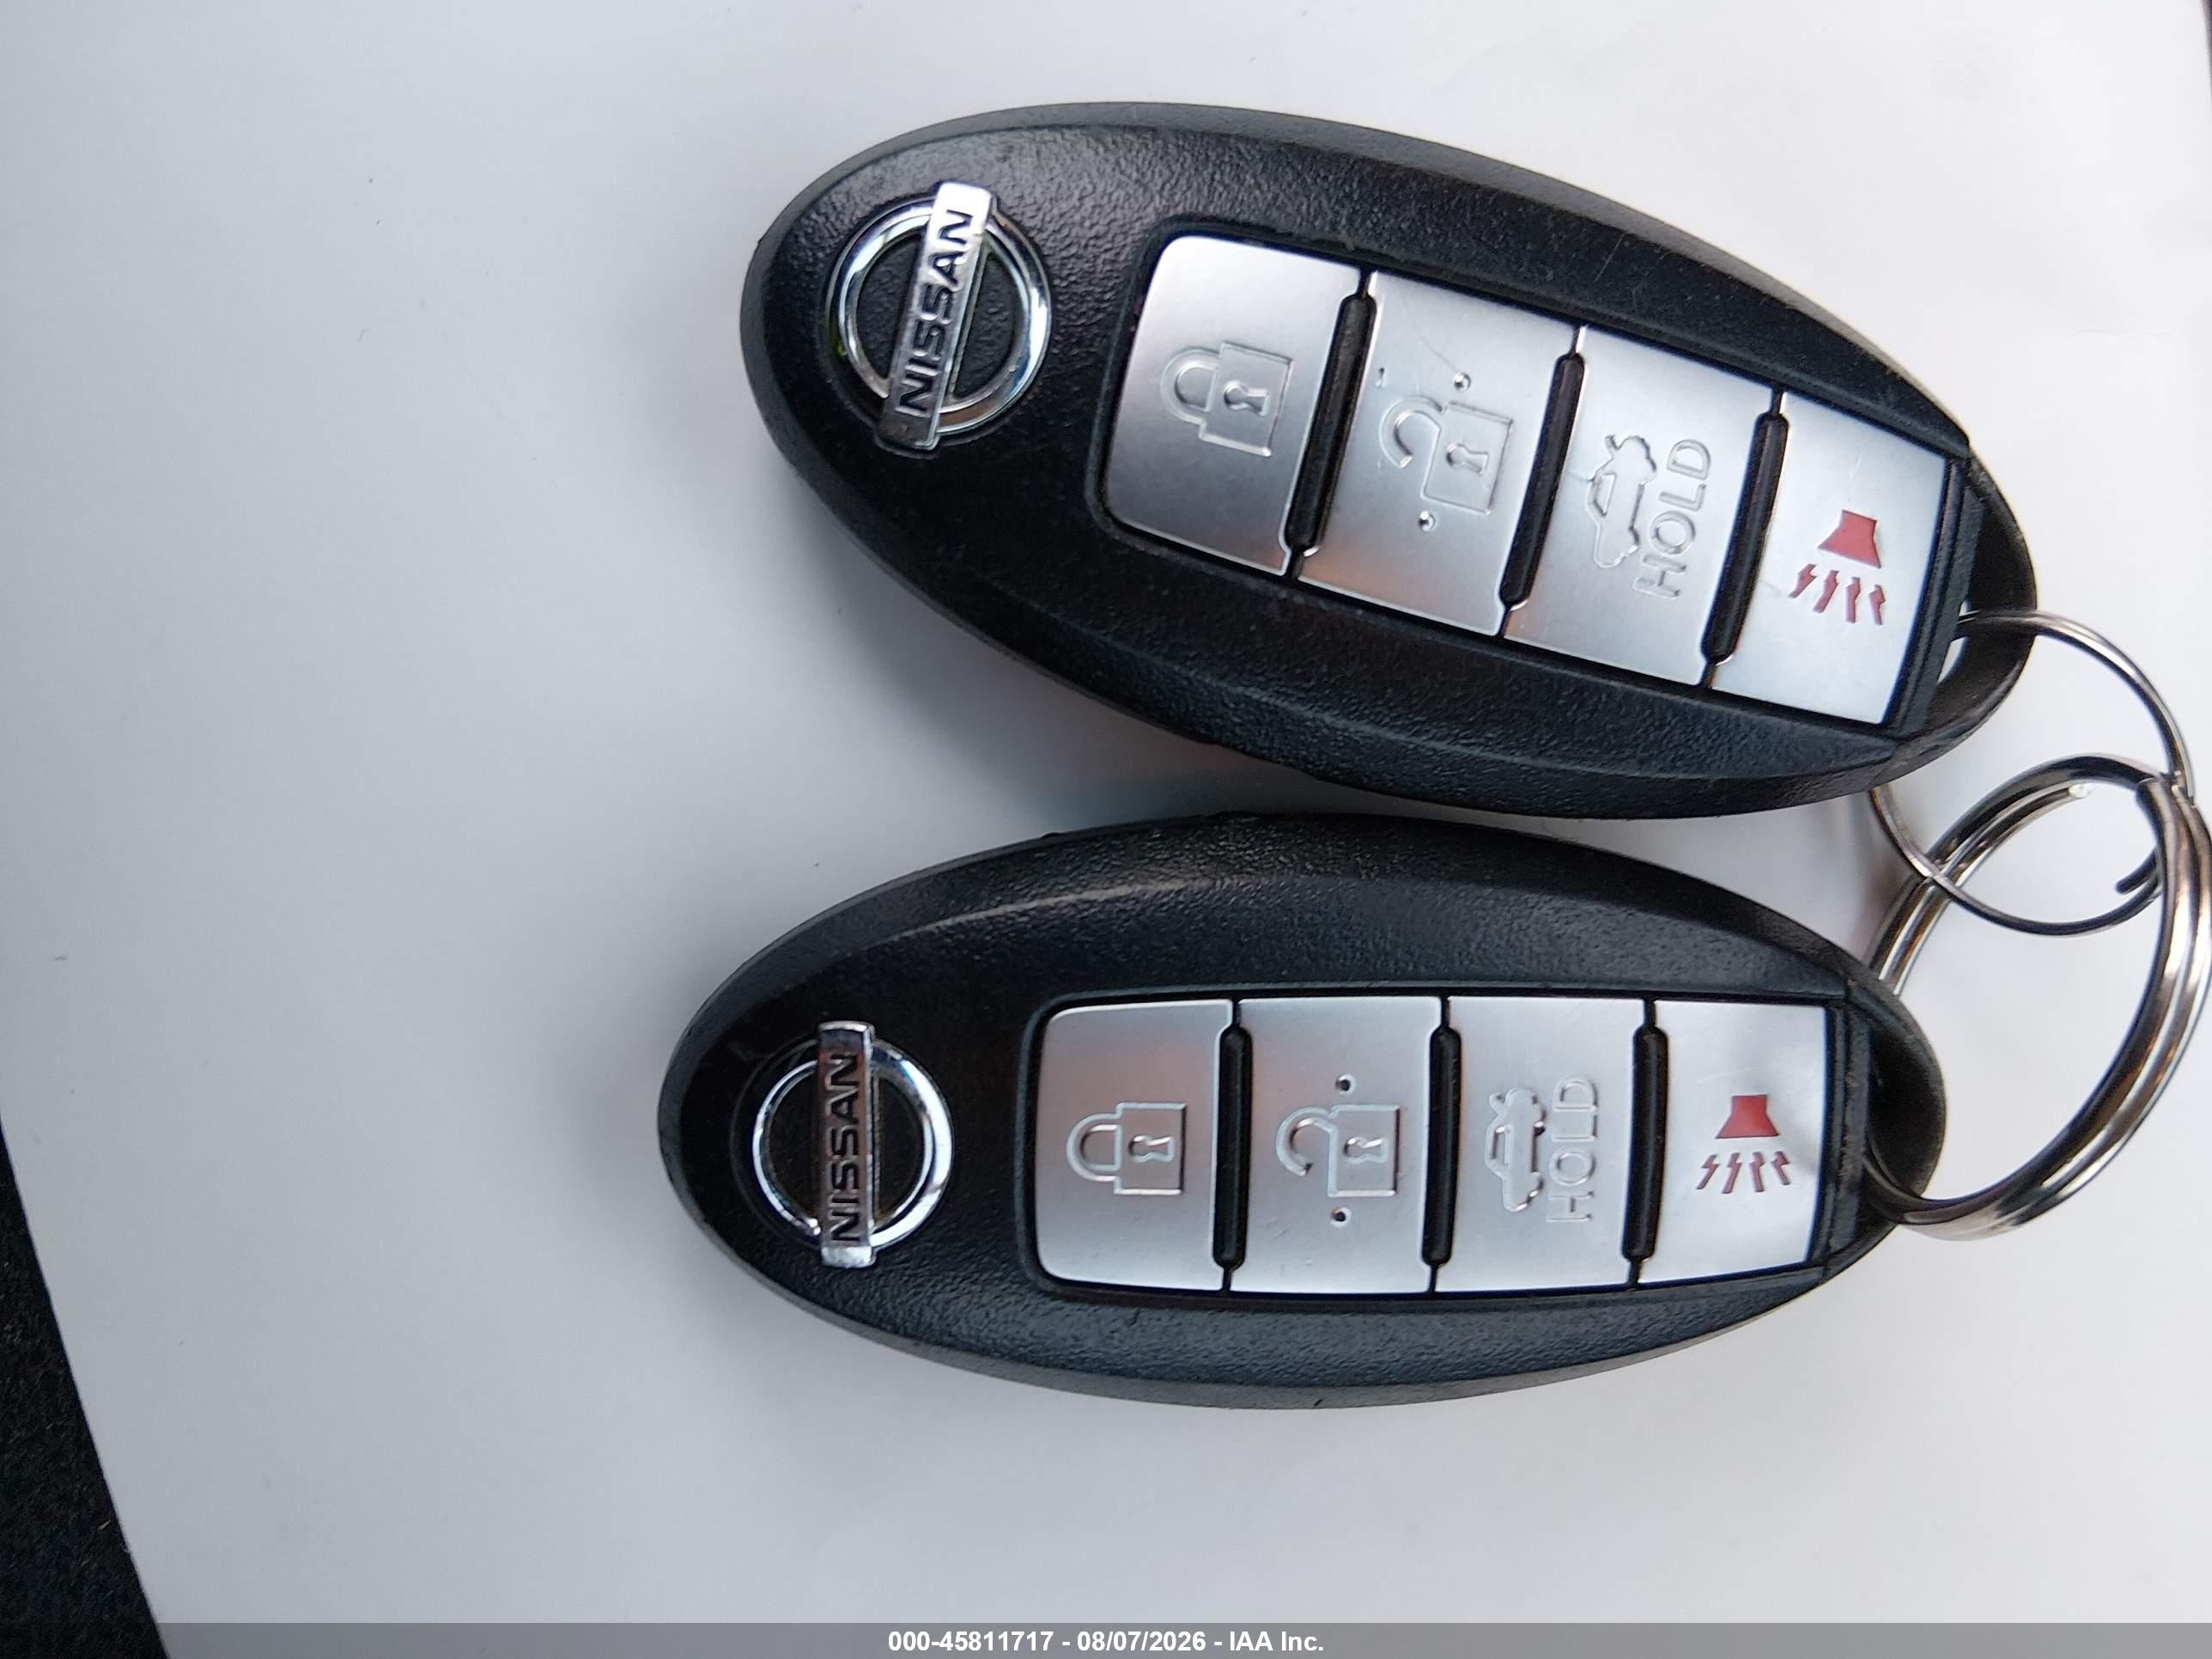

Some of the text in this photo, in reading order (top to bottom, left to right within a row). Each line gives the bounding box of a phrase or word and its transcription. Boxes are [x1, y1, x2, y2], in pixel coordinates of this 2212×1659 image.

[894, 209, 975, 418] NISSAN
[1632, 439, 1711, 599] HOLD
[829, 1053, 861, 1243] NISSAN
[1547, 1075, 1598, 1223] HOLD
